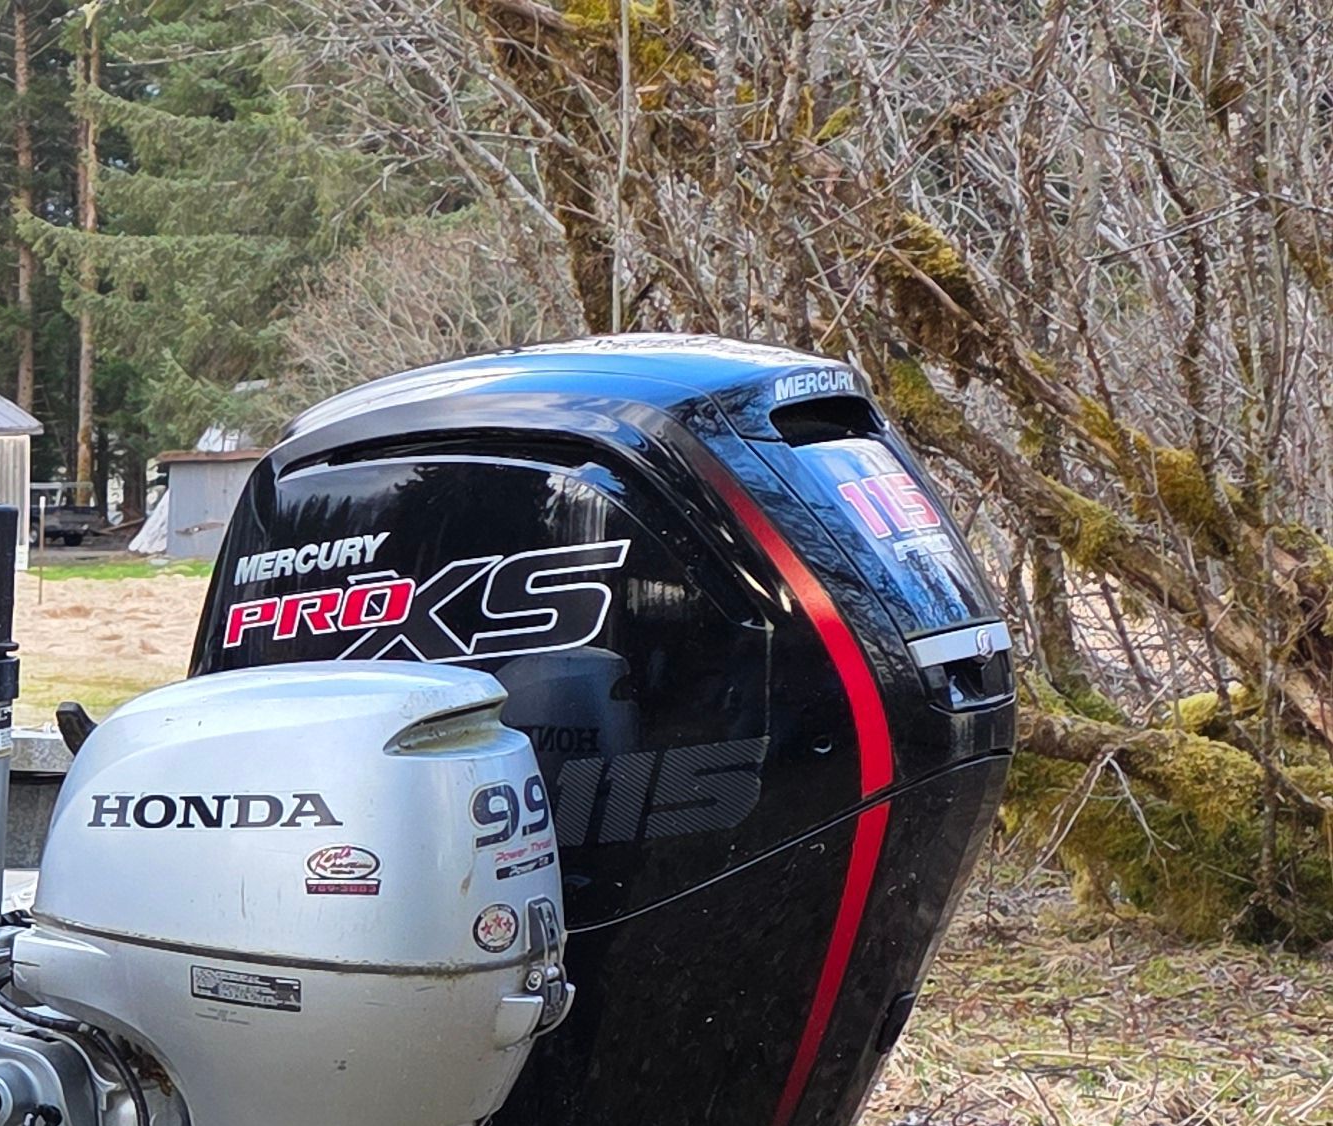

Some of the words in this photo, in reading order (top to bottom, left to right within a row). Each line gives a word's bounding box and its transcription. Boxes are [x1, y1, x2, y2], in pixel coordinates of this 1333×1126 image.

[774, 371, 856, 401] MERCURY
[837, 472, 941, 540] 115
[234, 531, 391, 586] MERCURY
[87, 793, 344, 829] HONDA
